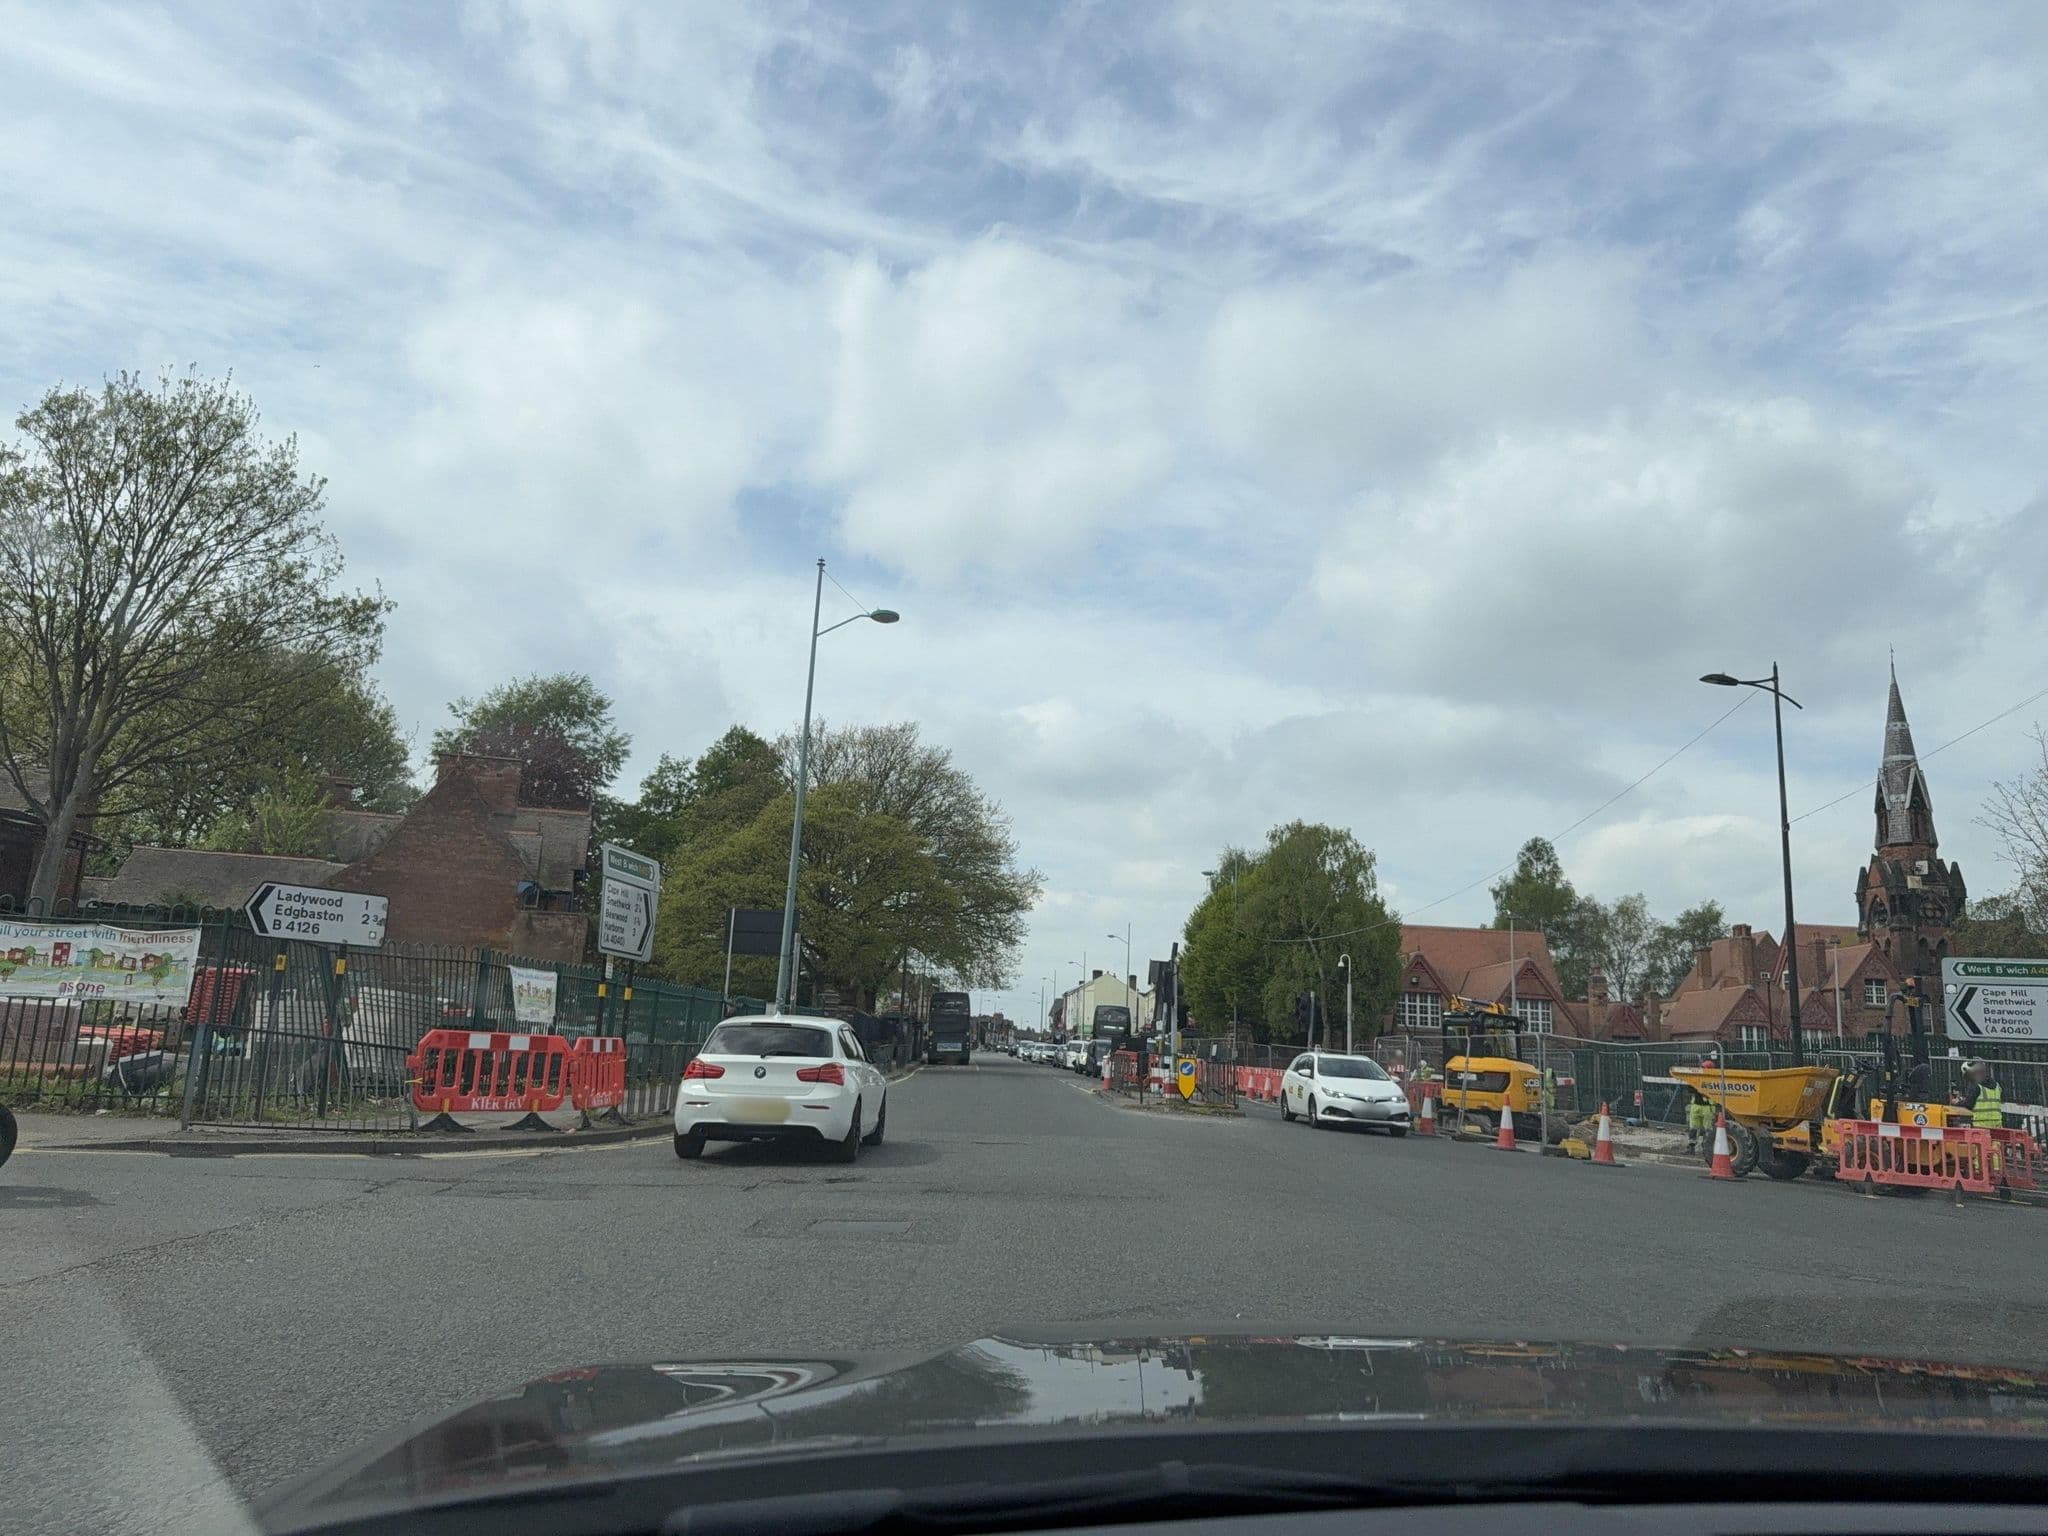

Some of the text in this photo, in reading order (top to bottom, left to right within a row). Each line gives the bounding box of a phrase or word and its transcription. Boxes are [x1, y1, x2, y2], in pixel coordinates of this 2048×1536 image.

[277, 889, 343, 908] Ladywood
[364, 900, 370, 911] 1
[275, 904, 344, 923] Edgbaston
[272, 920, 320, 935] B 4126
[13, 928, 43, 938] your
[47, 927, 88, 939] street
[92, 930, 117, 941] with
[119, 933, 193, 945] friendliness
[1967, 965, 1992, 974] West
[1981, 988, 2028, 998] Cape Hill
[1983, 998, 2036, 1006] Smethwick
[1983, 1007, 2033, 1016] Bearwood
[1984, 1017, 2030, 1026] Harborne
[1985, 1025, 2033, 1036] (A 4040)
[1523, 1078, 1541, 1087] JCB
